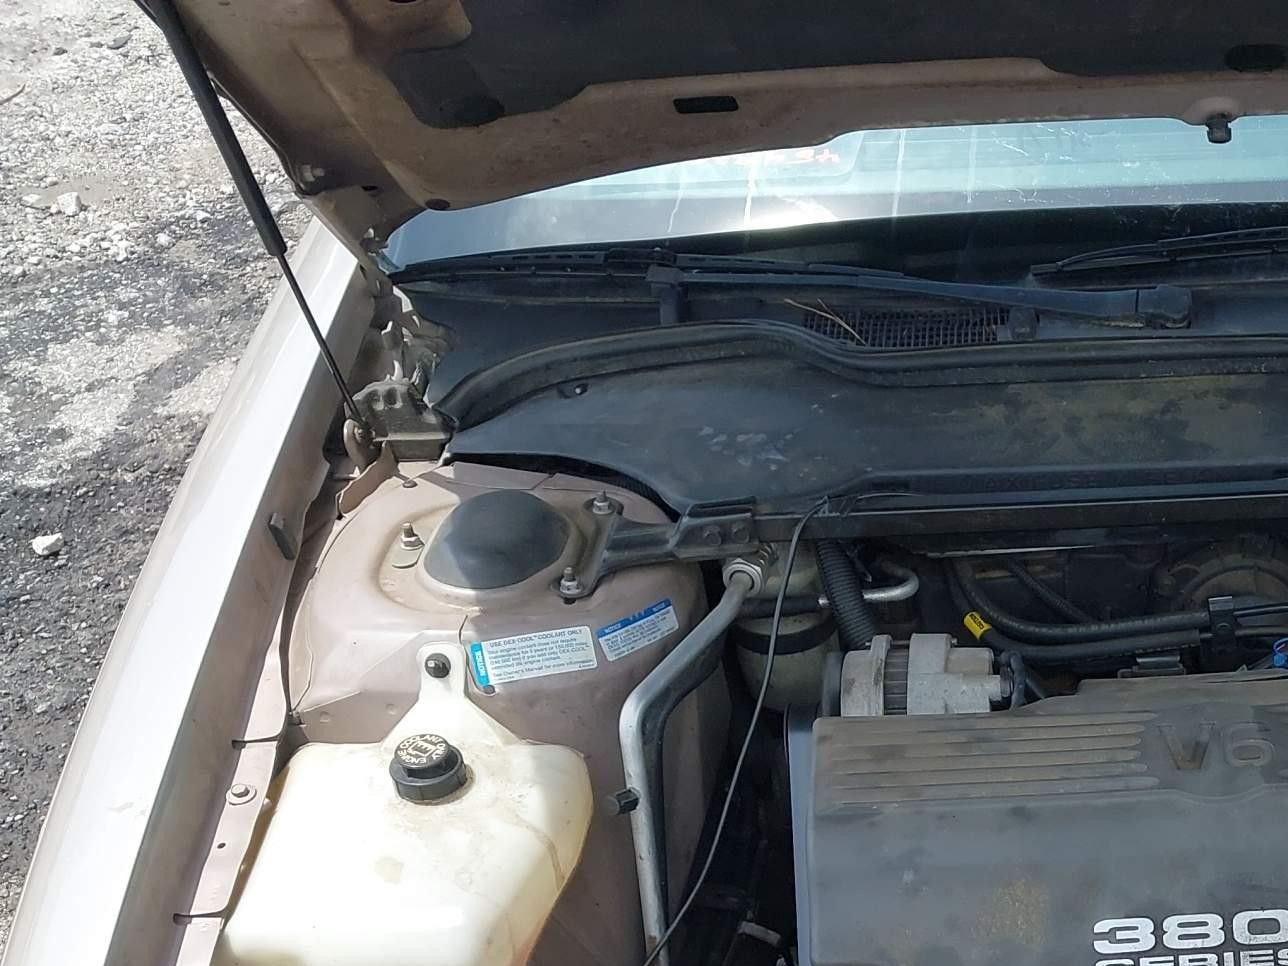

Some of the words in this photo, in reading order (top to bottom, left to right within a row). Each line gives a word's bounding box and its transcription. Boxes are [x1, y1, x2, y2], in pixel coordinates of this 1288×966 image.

[400, 734, 443, 749] COOLANT
[1154, 721, 1275, 770] V6
[397, 749, 427, 764] ENGINE
[432, 743, 447, 760] ONLY
